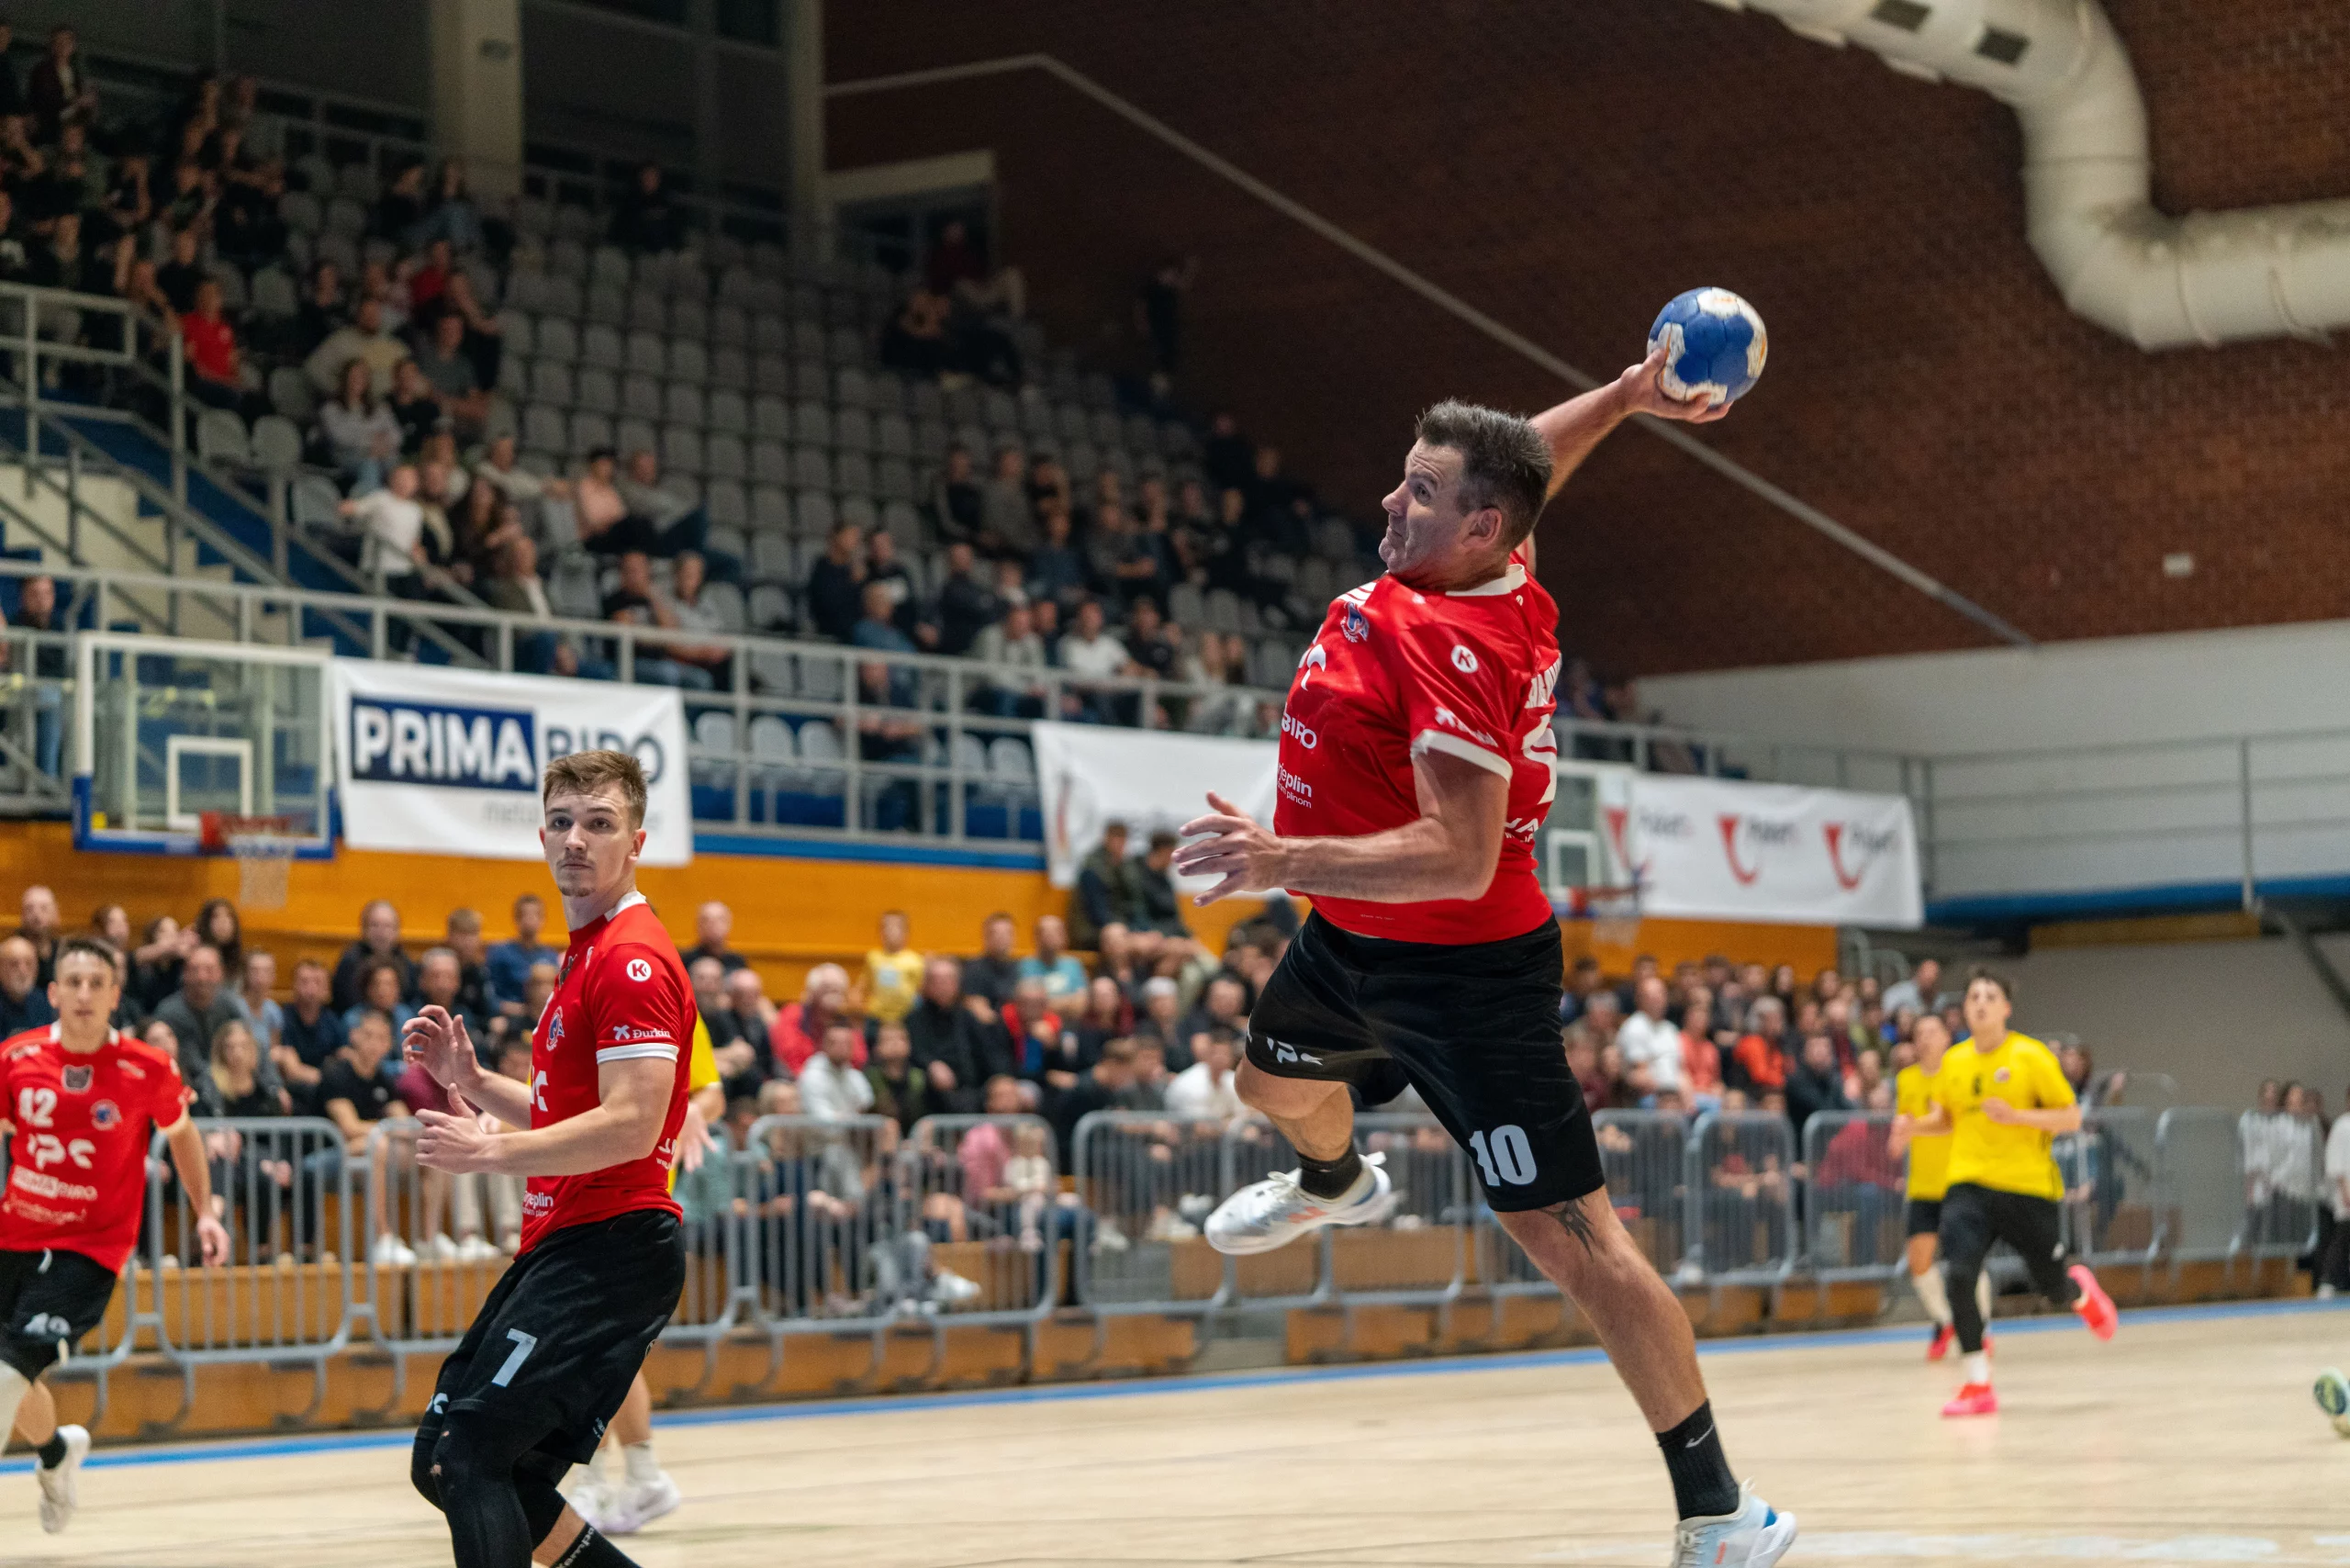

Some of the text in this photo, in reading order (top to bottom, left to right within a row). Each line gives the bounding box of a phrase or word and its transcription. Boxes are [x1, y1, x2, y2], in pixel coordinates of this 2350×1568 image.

[355, 705, 534, 785] PRIMA
[18, 1087, 58, 1129] 12
[1469, 1124, 1538, 1187] 10
[491, 1327, 538, 1388] 7
